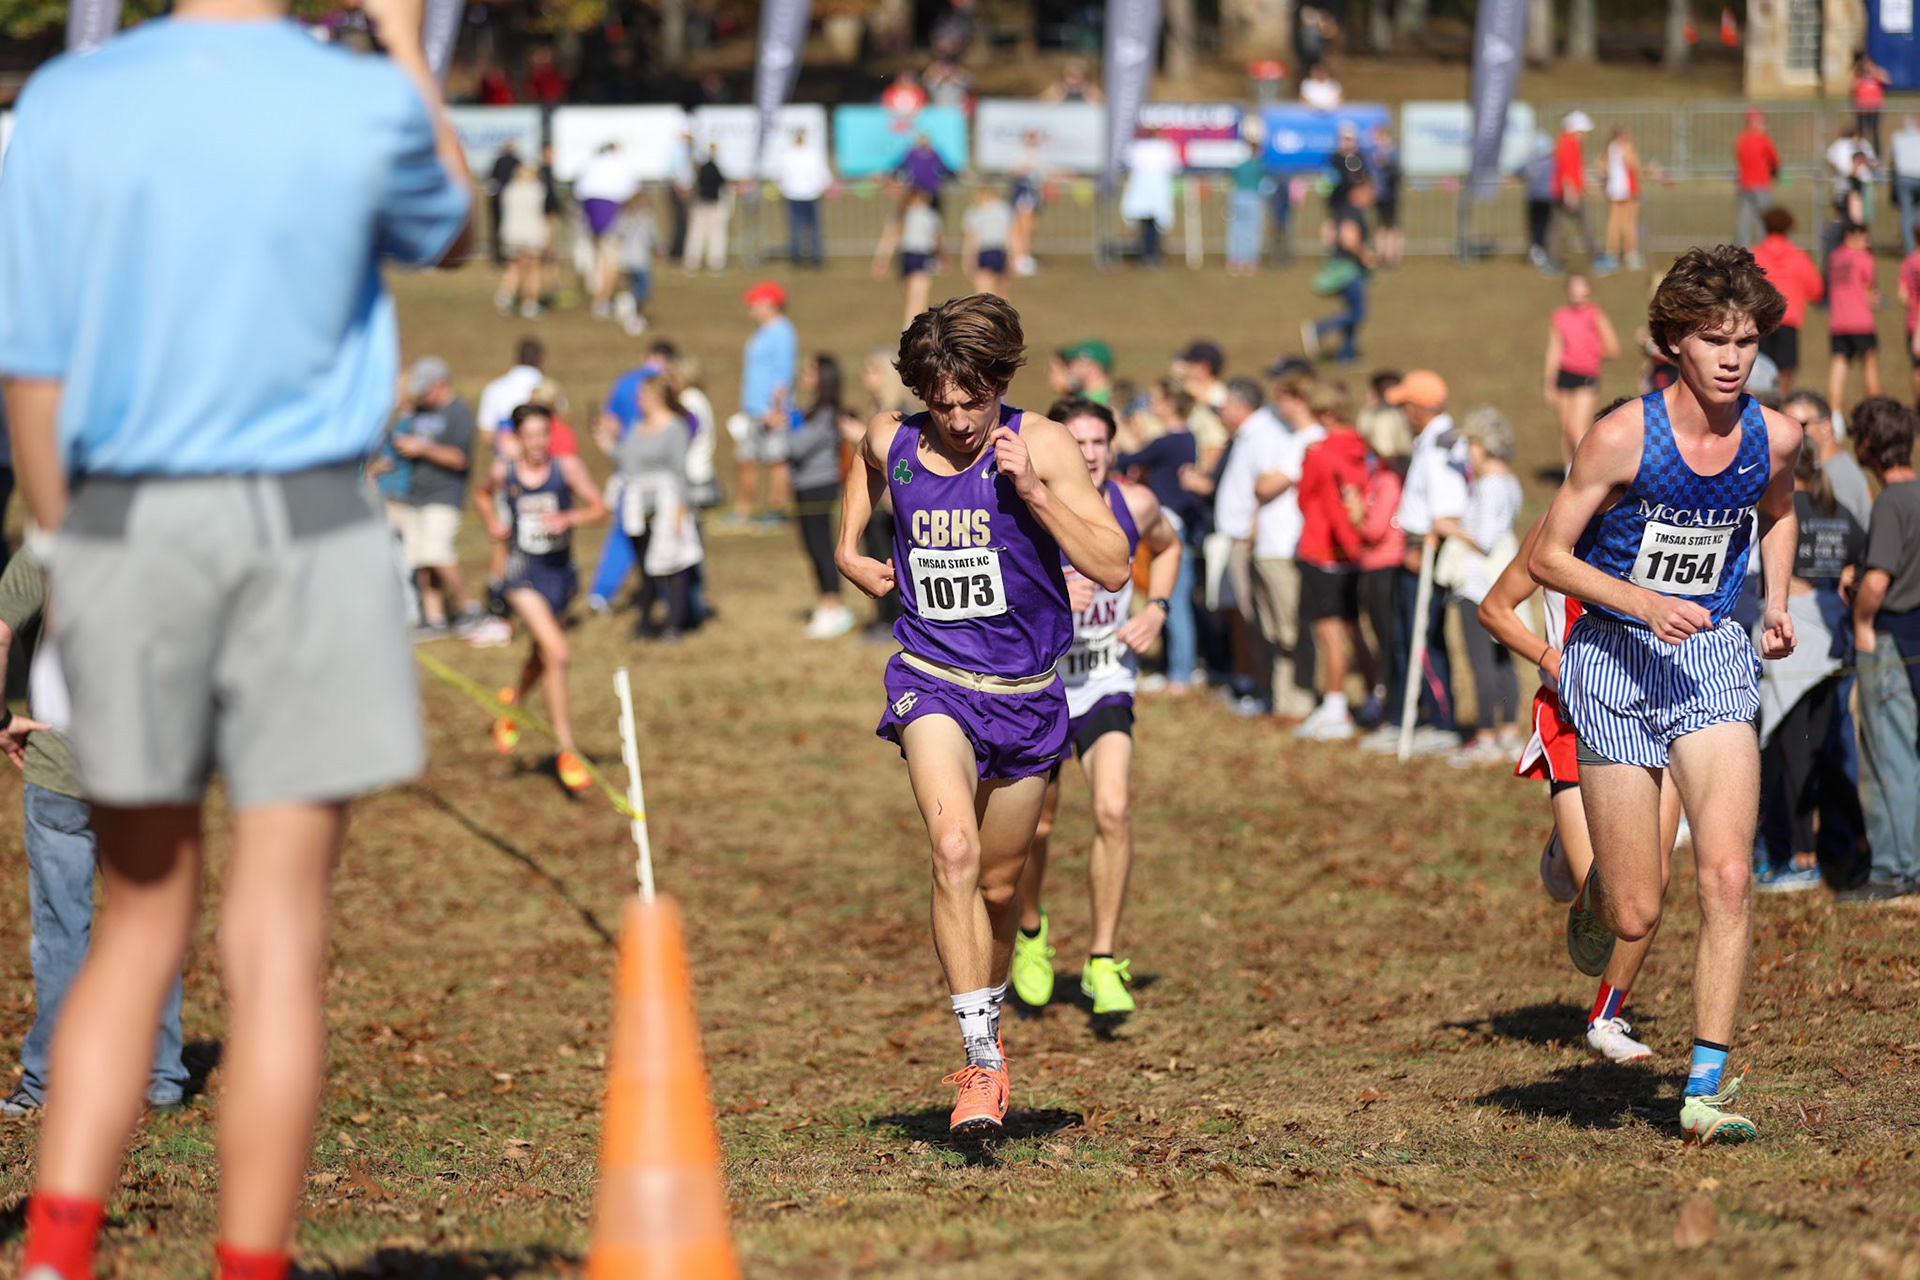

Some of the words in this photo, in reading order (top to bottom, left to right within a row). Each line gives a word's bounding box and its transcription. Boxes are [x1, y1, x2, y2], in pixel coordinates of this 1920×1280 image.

[912, 509, 991, 547] CBHS
[1655, 532, 1685, 545] TMSAA
[1687, 535, 1712, 546] STATE
[1713, 534, 1723, 545] XC
[917, 557, 947, 569] TMSAA
[948, 558, 976, 569] STATE
[977, 555, 990, 566] XC
[1646, 551, 1717, 585] 1154
[920, 574, 995, 610] 1073
